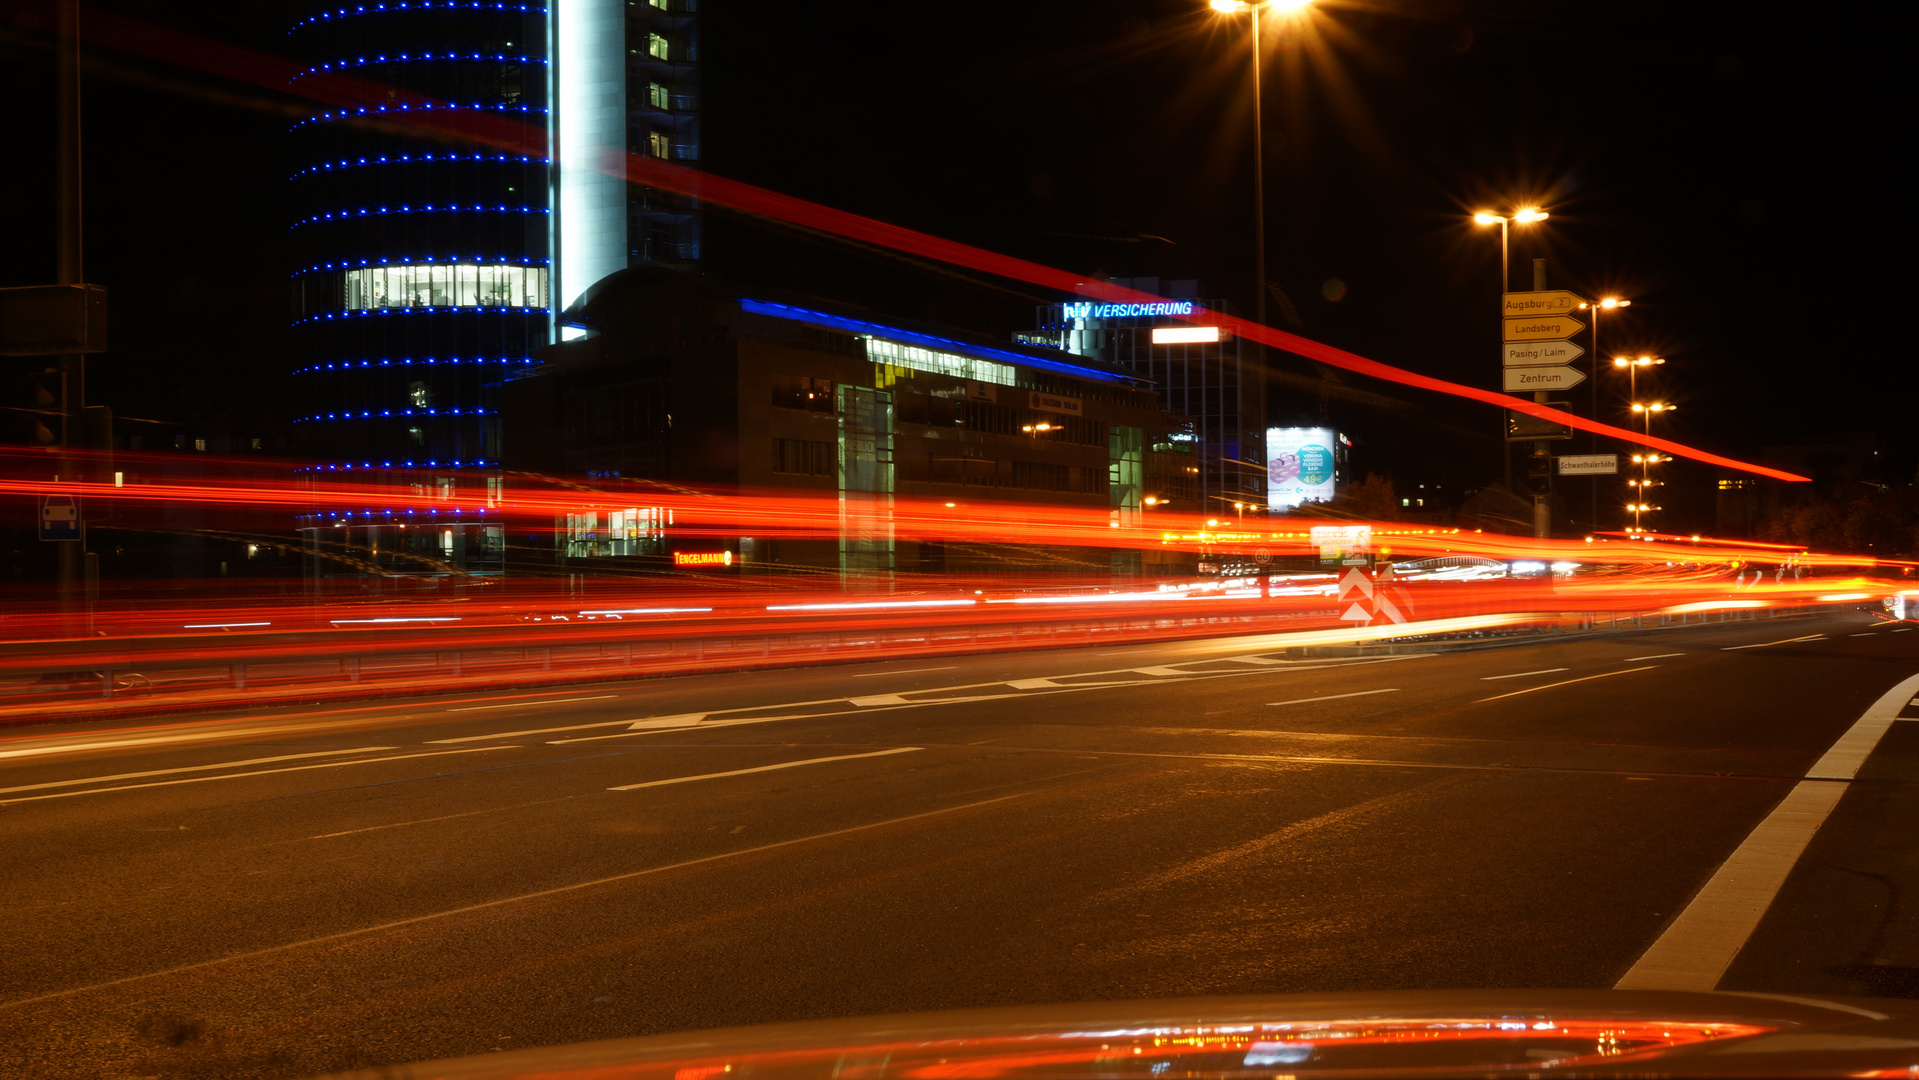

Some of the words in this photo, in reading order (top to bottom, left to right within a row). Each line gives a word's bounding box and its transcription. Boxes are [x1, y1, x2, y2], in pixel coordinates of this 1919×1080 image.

[1094, 302, 1192, 317] VERSICHERUNG
[1505, 299, 1552, 311] Augsburg
[1515, 323, 1561, 333] Landsberg
[1509, 349, 1538, 359] Pasing
[1544, 348, 1566, 357] Laim
[1520, 373, 1561, 384] Zentrum
[1560, 461, 1615, 469] Schwanthalerhöhe
[1304, 475, 1323, 483] 49€
[674, 552, 723, 565] TENGELMANN
[1256, 550, 1271, 561] 60
